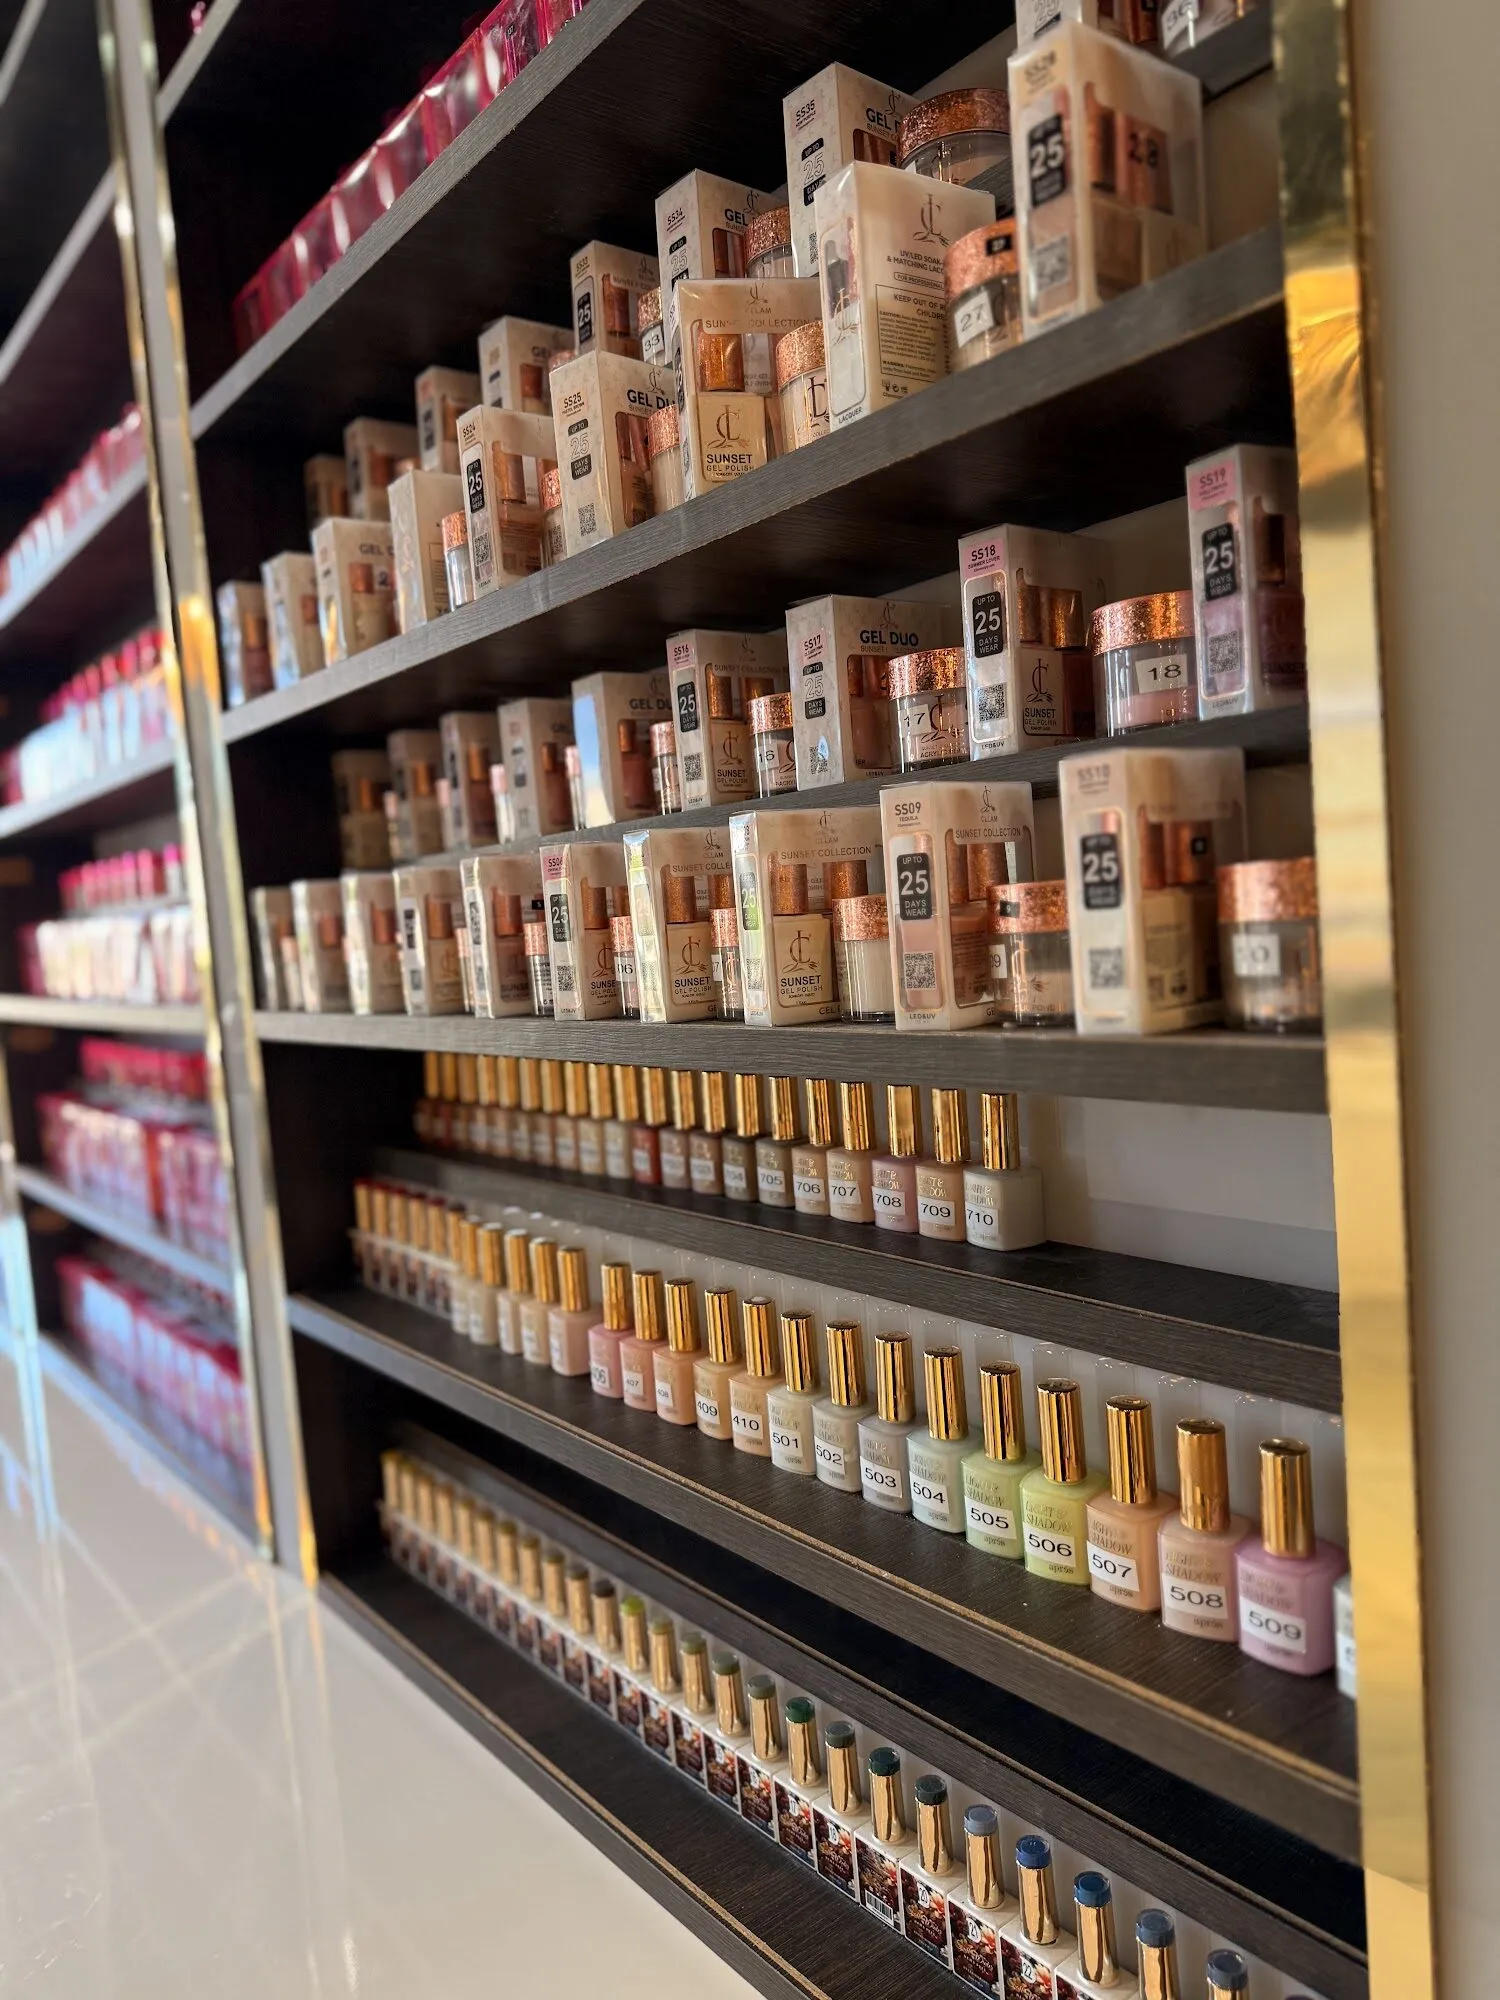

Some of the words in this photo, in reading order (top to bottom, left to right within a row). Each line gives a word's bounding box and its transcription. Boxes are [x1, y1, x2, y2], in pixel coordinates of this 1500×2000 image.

[795, 99, 816, 122] SS35
[866, 107, 892, 131] GEL
[1029, 133, 1064, 178] 25
[803, 152, 825, 185] 25
[725, 208, 749, 226] GEL
[671, 248, 688, 277] 25
[893, 257, 928, 270] MATCHING
[900, 250, 922, 261] UV/LED
[893, 293, 911, 303] KEEP
[913, 298, 926, 307] OUT
[928, 301, 938, 310] OF
[578, 304, 592, 328] 25
[961, 304, 984, 333] 27
[644, 334, 660, 352] 33
[563, 391, 582, 409] SS25
[627, 389, 653, 407] GEL
[838, 406, 863, 424] LACQUER
[463, 422, 476, 437] SS24
[569, 432, 590, 460] 25
[574, 458, 588, 468] DAYS
[706, 454, 753, 464] SUNSET
[574, 464, 589, 476] WEAR
[468, 472, 483, 496] 25
[1200, 468, 1226, 489] SS19
[971, 544, 996, 562] SS18
[1205, 542, 1233, 574] 25
[968, 559, 985, 569] SUMMER
[1210, 574, 1232, 587] DAYS
[1210, 584, 1232, 596] WEAR
[977, 597, 986, 606] UP
[986, 595, 996, 603] TO
[975, 607, 1001, 635] 25
[804, 634, 821, 651] SS17
[859, 630, 887, 645] GEL
[890, 631, 919, 647] DUO
[979, 635, 999, 647] DAYS
[674, 644, 689, 657] SS16
[980, 644, 999, 654] WEAR
[1148, 664, 1181, 680] 18
[804, 675, 824, 700] 25
[629, 698, 654, 710] GEL
[679, 694, 696, 714] 25
[808, 700, 823, 709] DAYS
[809, 707, 823, 716] WEAR
[904, 712, 925, 727] 17
[1024, 707, 1056, 718] SUNSET
[758, 750, 775, 763] 16
[717, 769, 746, 778] SUNSET
[895, 802, 921, 816] SS09
[955, 829, 981, 839] SUNSET
[983, 827, 1021, 837] COLLECTION
[781, 851, 815, 860] SUNSET
[819, 847, 871, 858] COLLECTION
[902, 857, 912, 865] UP
[912, 856, 922, 864] TO
[672, 864, 704, 873] SUNSET
[706, 862, 732, 871] COLLE
[1084, 852, 1118, 883] 25
[900, 870, 929, 896] 25
[742, 888, 757, 908] 25
[904, 900, 926, 909] DAYS
[552, 906, 568, 924] 25
[905, 907, 927, 916] WEAR
[1006, 905, 1011, 914] 9
[591, 980, 616, 989] SUNSE
[675, 977, 710, 988] SUNSET
[780, 975, 821, 988] SUNSET
[797, 985, 823, 993] POLISH
[819, 1007, 835, 1015] GEL
[986, 1009, 996, 1017] GE
[760, 1172, 783, 1185] 705
[797, 1181, 821, 1194] 706
[832, 1185, 857, 1197] 707
[876, 1193, 901, 1208] 708
[922, 1203, 951, 1218] 709
[967, 1208, 994, 1226] 710
[626, 1379, 639, 1389] 407
[657, 1388, 669, 1399] 408
[697, 1400, 718, 1416] 409
[732, 1415, 759, 1431] 410
[772, 1433, 799, 1448] 501
[816, 1445, 842, 1466] 502
[865, 1467, 897, 1488] 503
[913, 1482, 946, 1504] 504
[971, 1507, 1009, 1530] 505
[1025, 1513, 1072, 1533] SHADOW
[1029, 1533, 1072, 1557] 506
[1090, 1533, 1132, 1555] SHADOW
[1092, 1553, 1132, 1578] 507
[1170, 1586, 1224, 1609] 508
[1249, 1611, 1301, 1640] 509
[829, 1826, 837, 1842] 18
[920, 1888, 928, 1904] 20
[970, 1922, 978, 1938] 21
[1023, 1961, 1033, 1980] 22
